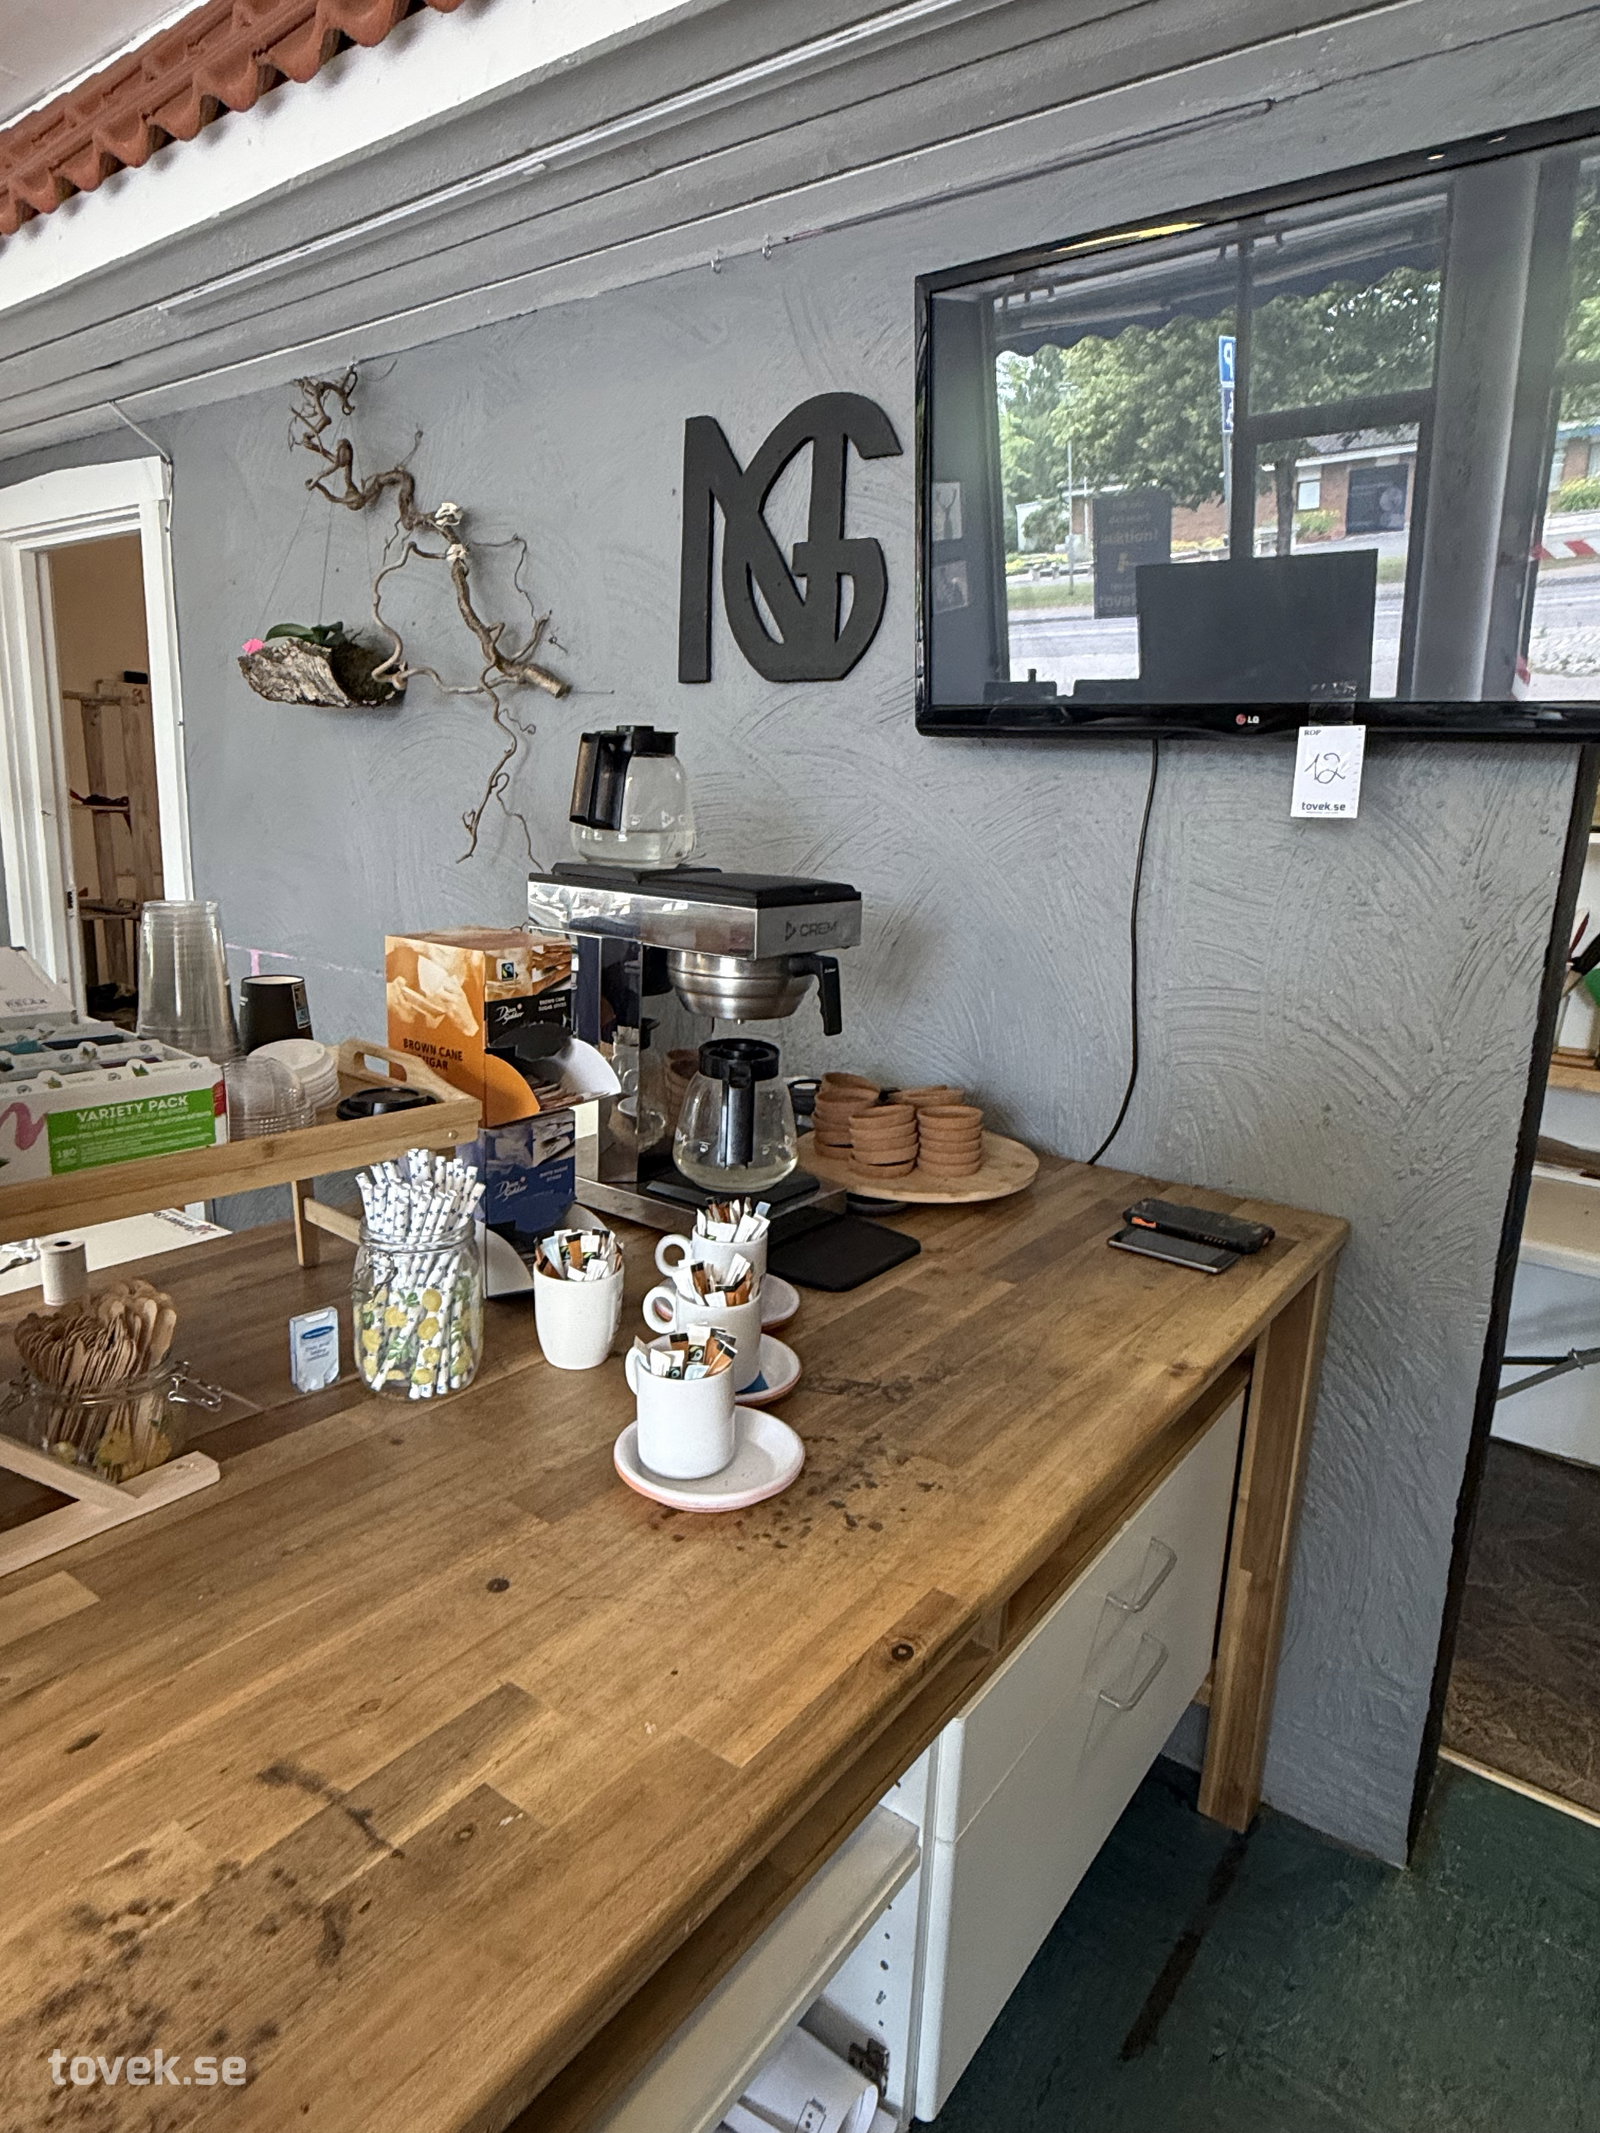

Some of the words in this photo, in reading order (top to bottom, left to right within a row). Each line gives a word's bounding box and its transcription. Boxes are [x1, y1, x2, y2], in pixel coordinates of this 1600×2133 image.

[1247, 715, 1260, 724] LG
[1304, 752, 1346, 784] 12
[1301, 801, 1346, 811] tovek.se
[403, 1038, 437, 1055] BROWN
[439, 1047, 463, 1062] CANE
[416, 1054, 448, 1070] UGAR
[77, 1102, 144, 1122] VARIETY
[148, 1095, 189, 1111] PACK
